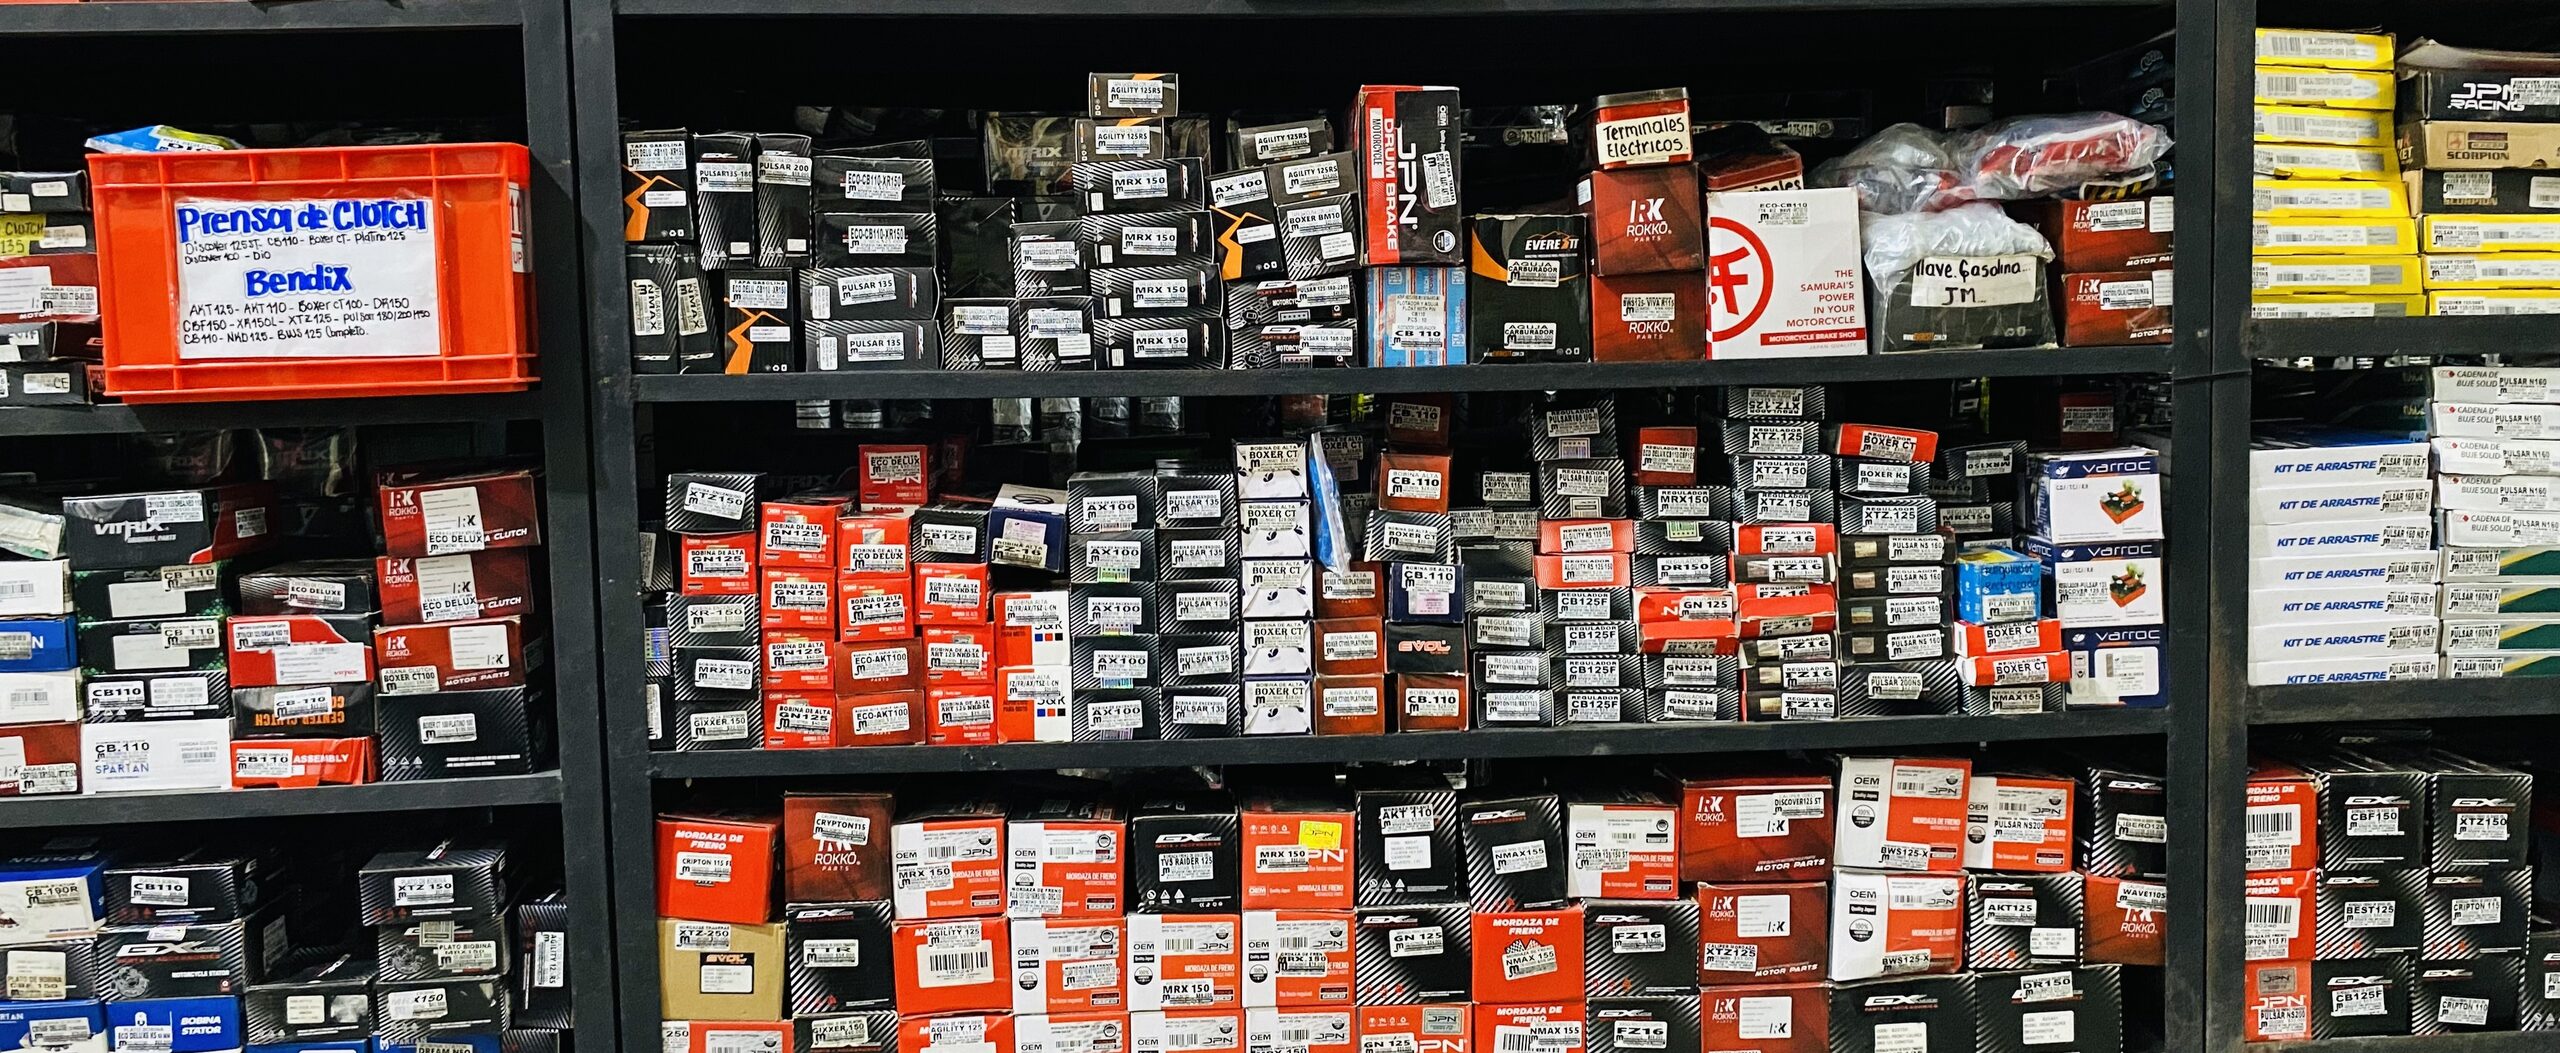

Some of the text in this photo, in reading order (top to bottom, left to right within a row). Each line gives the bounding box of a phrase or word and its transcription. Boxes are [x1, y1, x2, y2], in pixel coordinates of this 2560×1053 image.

[1604, 117, 1685, 141] Terminales
[1607, 137, 1683, 157] Electricos
[2447, 151, 2509, 160] SCORPION
[1115, 177, 1165, 186] MRX 150
[1215, 179, 1262, 193] AX 100
[1384, 118, 1398, 250] DRUM BRAKE
[177, 206, 293, 243] Prensa
[298, 204, 328, 230] de
[1125, 233, 1175, 242] MRX 150
[1835, 270, 1853, 278] THE
[842, 280, 892, 292] PULSAR 135
[1135, 286, 1185, 294] MRX 150
[1819, 293, 1854, 302] POWER
[1828, 305, 1854, 313] YOUR
[1787, 316, 1855, 328] MOTORCYCLE
[1769, 333, 1814, 342] MOTORCYCLE
[1249, 450, 1298, 459] BOXER CT
[2274, 460, 2376, 473] KIT DE ARRASTRE
[1660, 495, 1709, 504] MRX150
[2280, 497, 2380, 510] KIT DE ARRASTRE
[1087, 503, 1135, 511] AX100
[1248, 509, 1296, 518] BOXER CT
[494, 528, 527, 541] CLUTCH
[770, 529, 820, 537] GN125
[922, 533, 973, 541] CB125F
[2277, 534, 2379, 546] KIT DE ARRASTRE
[1561, 597, 1607, 605] CB125F
[1092, 605, 1140, 613] AX100
[1570, 631, 1616, 639] CB125F
[699, 667, 751, 675] MRX150
[1666, 664, 1714, 672] GN125H
[445, 671, 510, 686] MOTOR PARTS
[92, 687, 142, 696] CB110
[293, 754, 349, 764] ASSEMBLY
[96, 763, 149, 774] SPARTAN
[1382, 808, 1431, 819] AKT 110
[2350, 812, 2397, 820] CBF150
[2460, 818, 2507, 826] XTZ150
[675, 830, 744, 843] MORDAZA DE
[690, 841, 726, 851] FRENO
[896, 852, 917, 860] OEM
[1755, 859, 1825, 872] MOTOR PARTS
[134, 883, 182, 891] CB110
[1988, 904, 2032, 912] AKT125
[2346, 906, 2393, 914] BEST125
[1493, 918, 1559, 927] MORDAZA DE
[1509, 927, 1544, 935] FRENO
[1420, 932, 1442, 940] 125
[1706, 949, 1756, 957] XTZ125
[1506, 952, 1554, 966] NMAX 155
[1755, 964, 1818, 977] MOTOR PARTS
[2023, 978, 2070, 989] DR150
[1497, 1006, 1563, 1015] MORDAZA DE
[181, 1016, 221, 1025] BOBINA
[181, 1026, 221, 1035] STATOR
[1530, 1026, 1579, 1035] NMAX 155
